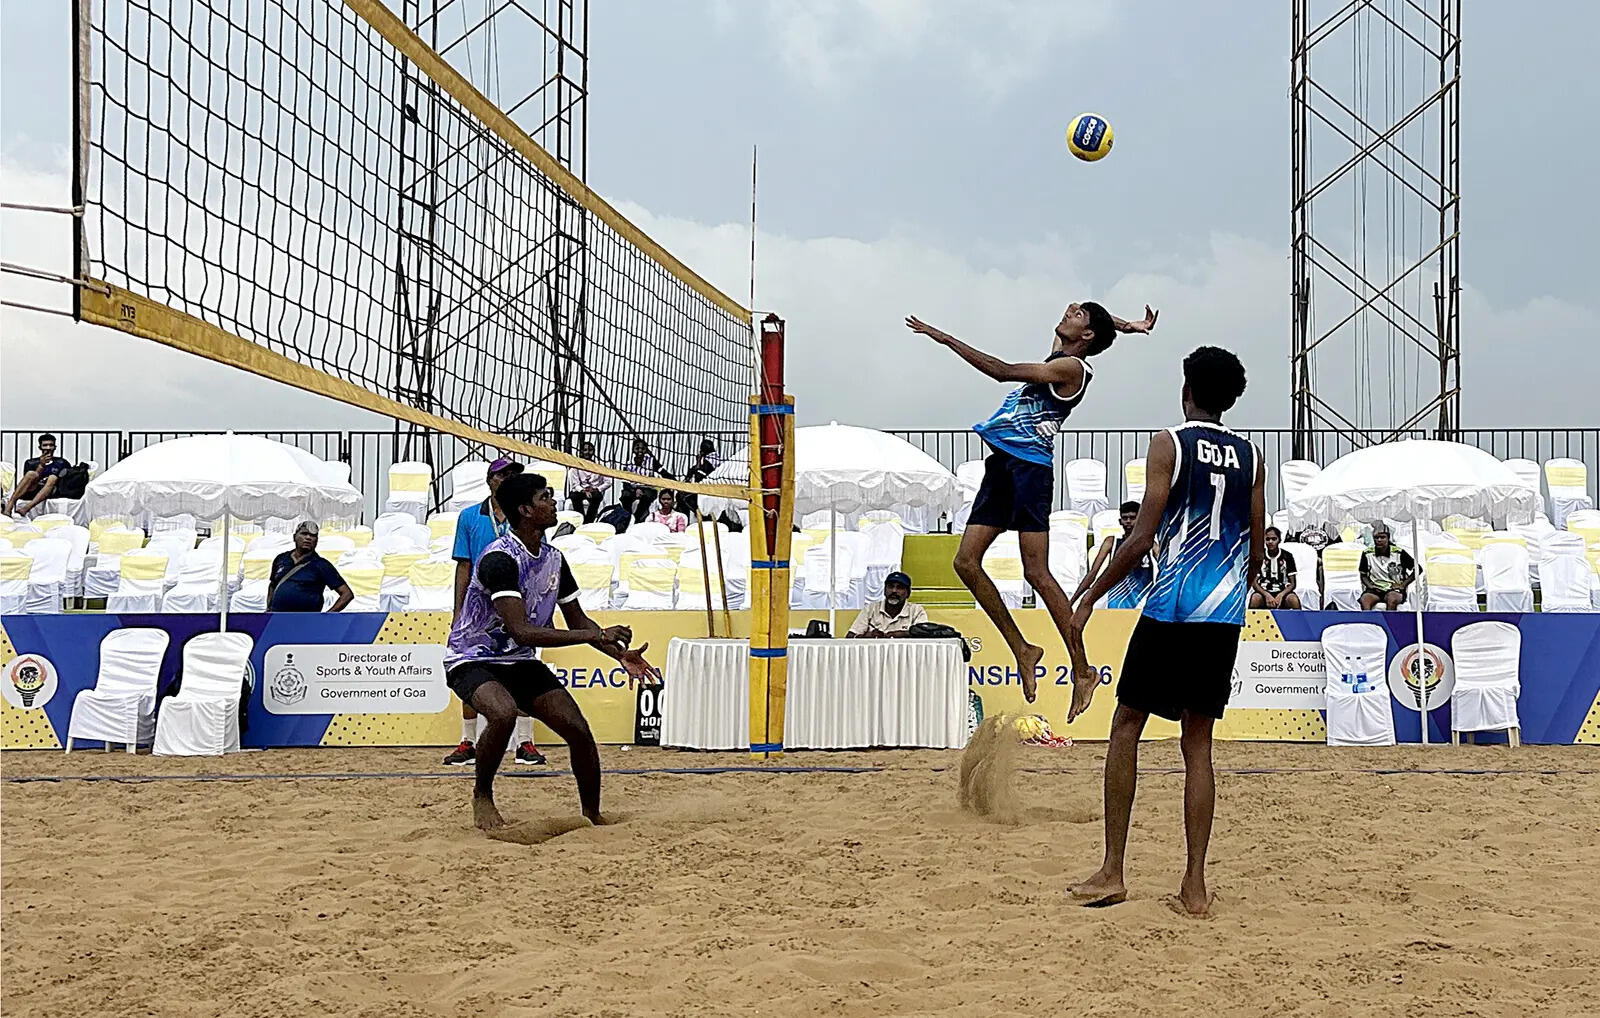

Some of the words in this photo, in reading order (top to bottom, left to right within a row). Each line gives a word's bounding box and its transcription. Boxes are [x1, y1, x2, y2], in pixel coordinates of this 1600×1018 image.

[1082, 118, 1098, 145] COSCO
[1197, 439, 1240, 469] GOA
[338, 652, 398, 663] Directorate
[400, 652, 413, 663] of
[315, 665, 351, 678] Sports
[354, 666, 363, 676] &
[365, 665, 398, 676] Youth
[398, 665, 433, 676] Affairs
[1250, 662, 1284, 674] Sports
[1286, 662, 1295, 672] &
[1297, 662, 1326, 672] Youth
[320, 688, 389, 699] Government
[390, 687, 402, 699] of
[403, 688, 427, 699] Goa
[1255, 683, 1319, 694] Government
